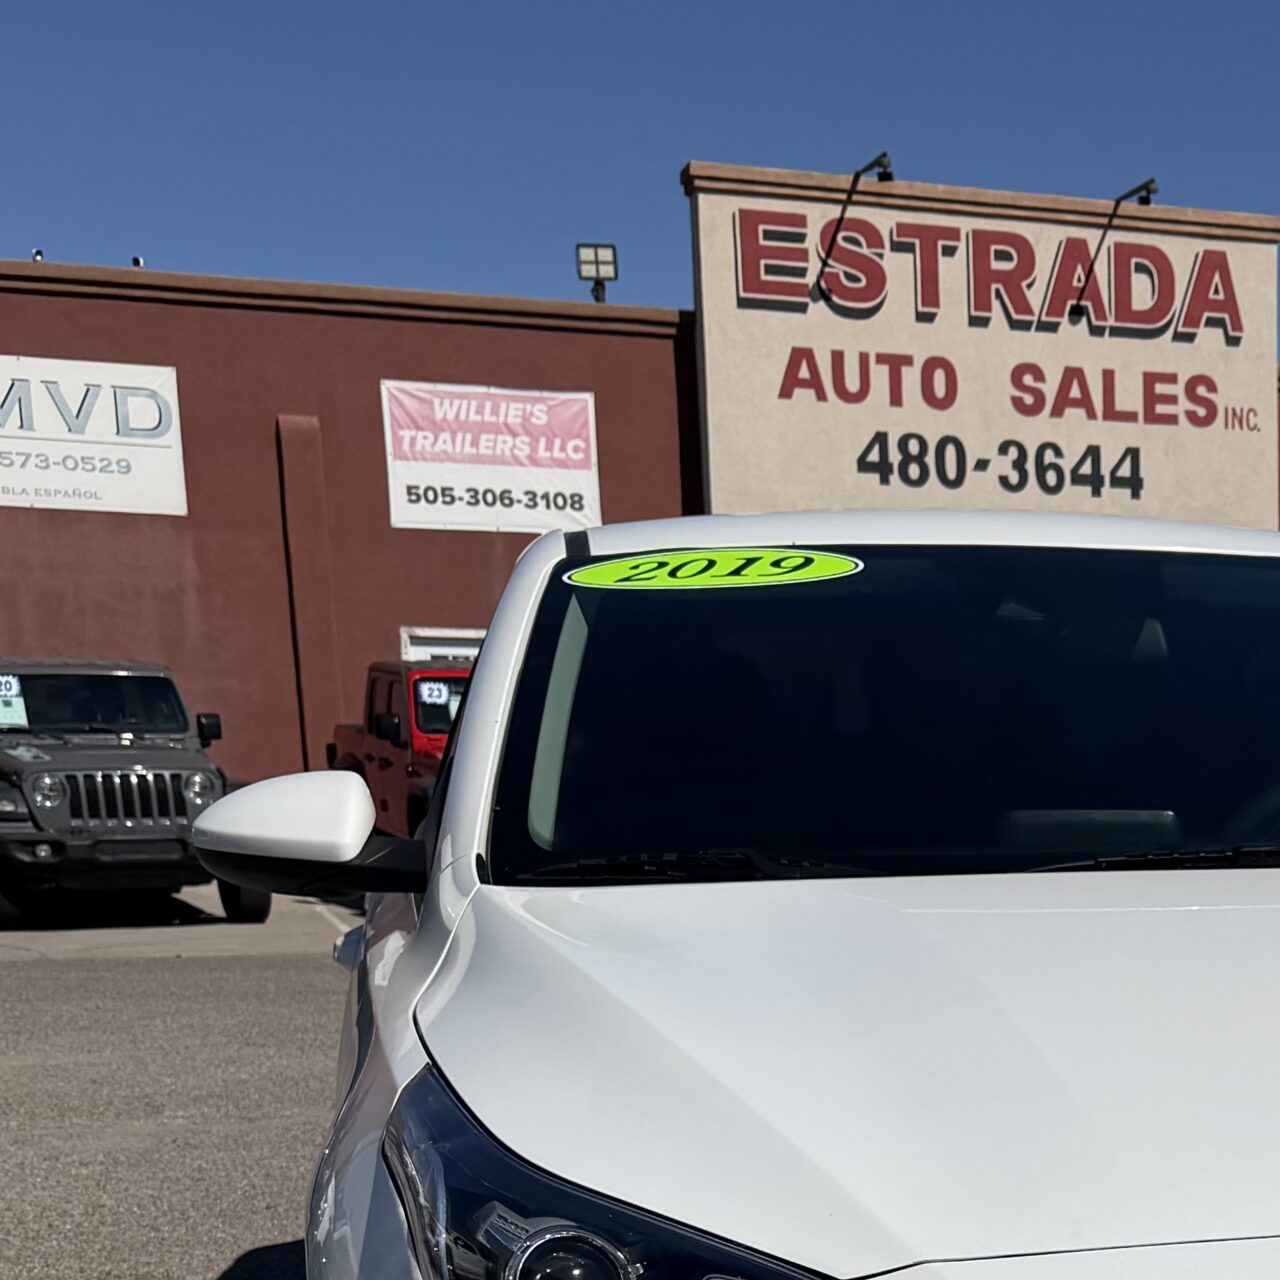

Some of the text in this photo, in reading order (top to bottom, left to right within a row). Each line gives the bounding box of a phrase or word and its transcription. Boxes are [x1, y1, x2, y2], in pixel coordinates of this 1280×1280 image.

[732, 208, 1244, 348] ESTRADA
[777, 346, 1261, 432] AUTO SALES INC.
[432, 397, 549, 426] WILLIE'S
[399, 429, 587, 460] TRAILERS LLC
[856, 431, 1144, 500] 480-3644
[0, 486, 103, 500] BLA ESPAÑOL
[406, 485, 585, 512] 505-306-3108
[613, 555, 816, 584] 2019
